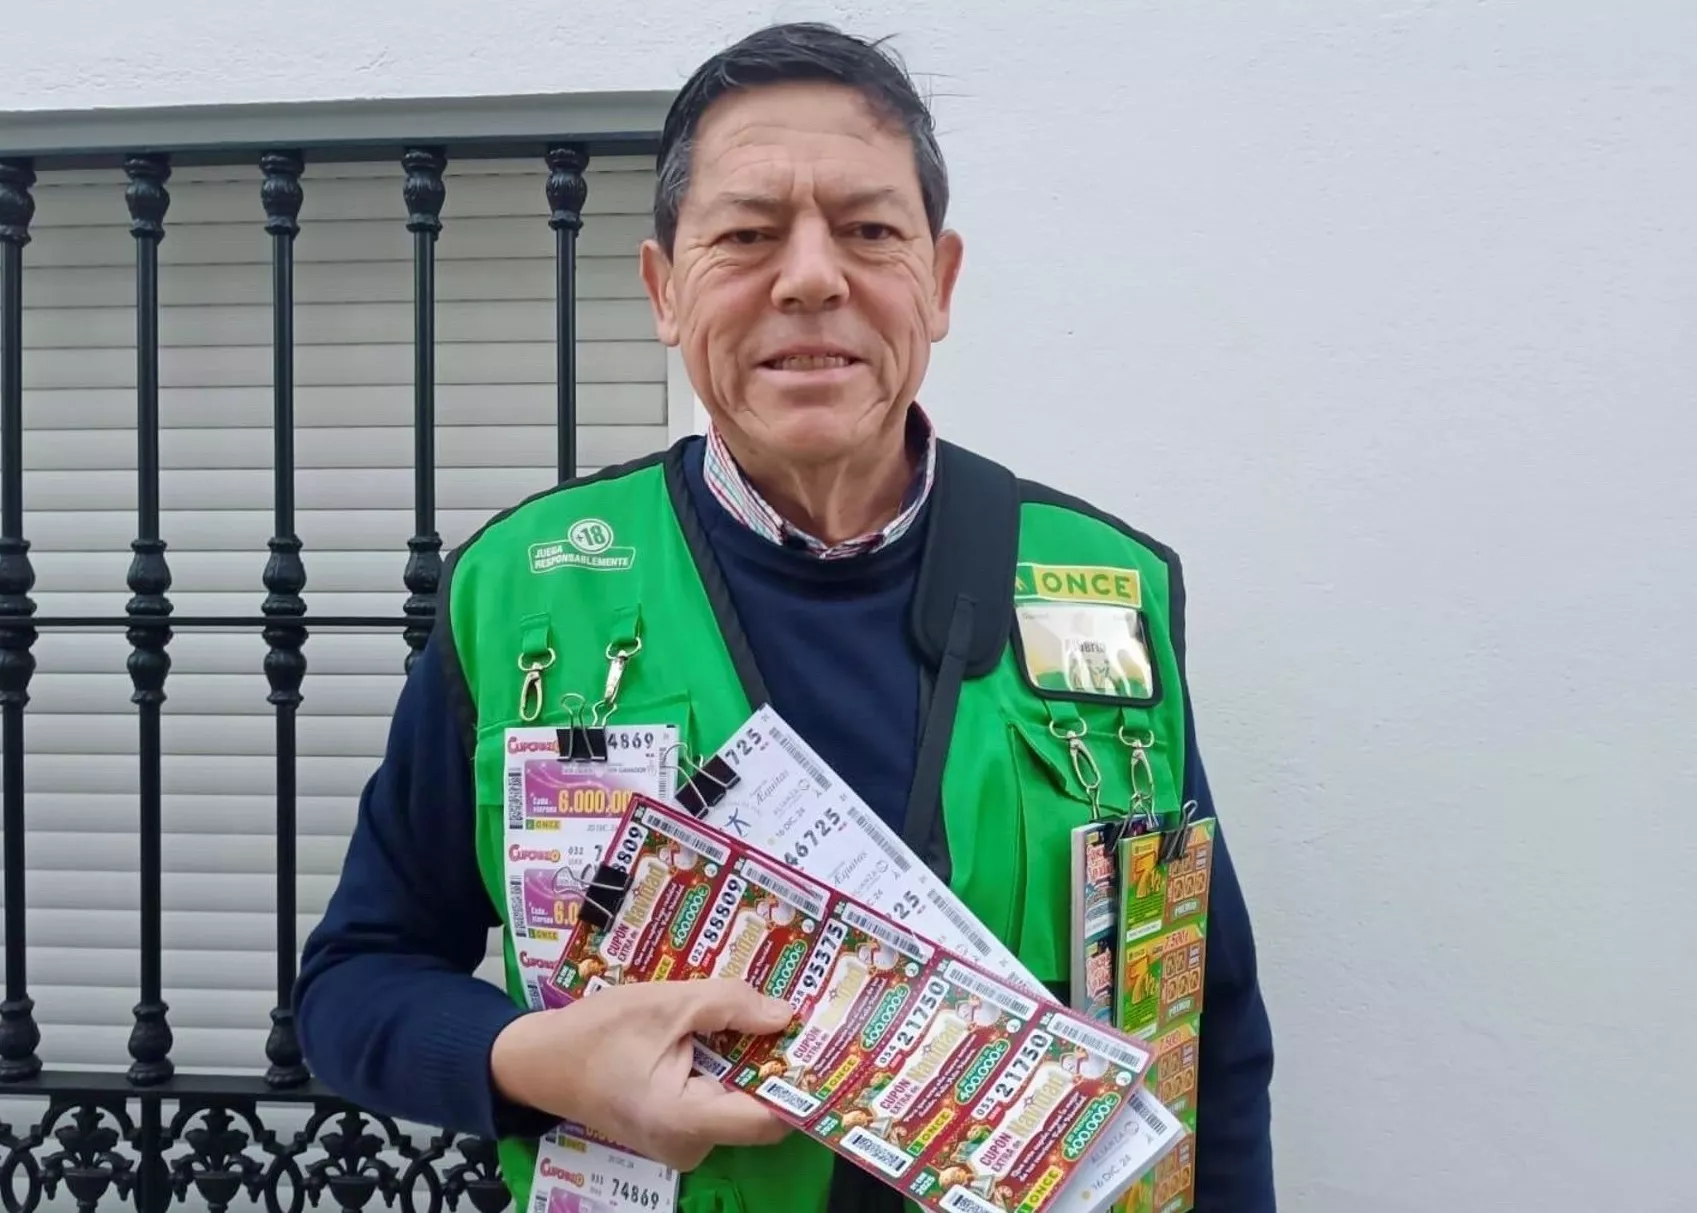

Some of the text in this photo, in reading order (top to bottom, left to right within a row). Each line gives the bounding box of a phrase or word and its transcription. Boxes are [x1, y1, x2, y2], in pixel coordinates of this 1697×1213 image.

[534, 545, 564, 560] JUEGA
[576, 524, 606, 547] +18
[534, 553, 630, 569] RESPONSABLEMENTE
[1042, 572, 1131, 598] ONCE
[725, 727, 763, 766] 725
[784, 807, 841, 867] 46725
[606, 922, 630, 957] CUPÓN
[623, 863, 668, 927] Navidad
[704, 878, 743, 944] 88809
[886, 889, 922, 921] 25
[617, 937, 633, 963] EXTRA
[803, 923, 843, 989] 95375
[897, 981, 945, 1046] 21750
[793, 1026, 822, 1060] CUPÓN
[802, 1040, 823, 1063] EXTRA
[829, 1057, 857, 1087] ONCE
[865, 986, 907, 1047] 400.000€
[995, 1033, 1049, 1098] 21750
[880, 1077, 911, 1111] CUPÓN
[890, 1091, 912, 1115] EXTRA
[922, 1110, 950, 1141] ONCE
[961, 1041, 1008, 1101] 400.000€
[980, 1131, 1013, 1167] CUPÓN
[991, 1147, 1015, 1173] EXTRA
[1029, 1170, 1060, 1204] ONCE
[1067, 1094, 1118, 1157] 400.000€
[612, 1178, 660, 1210] 74869
